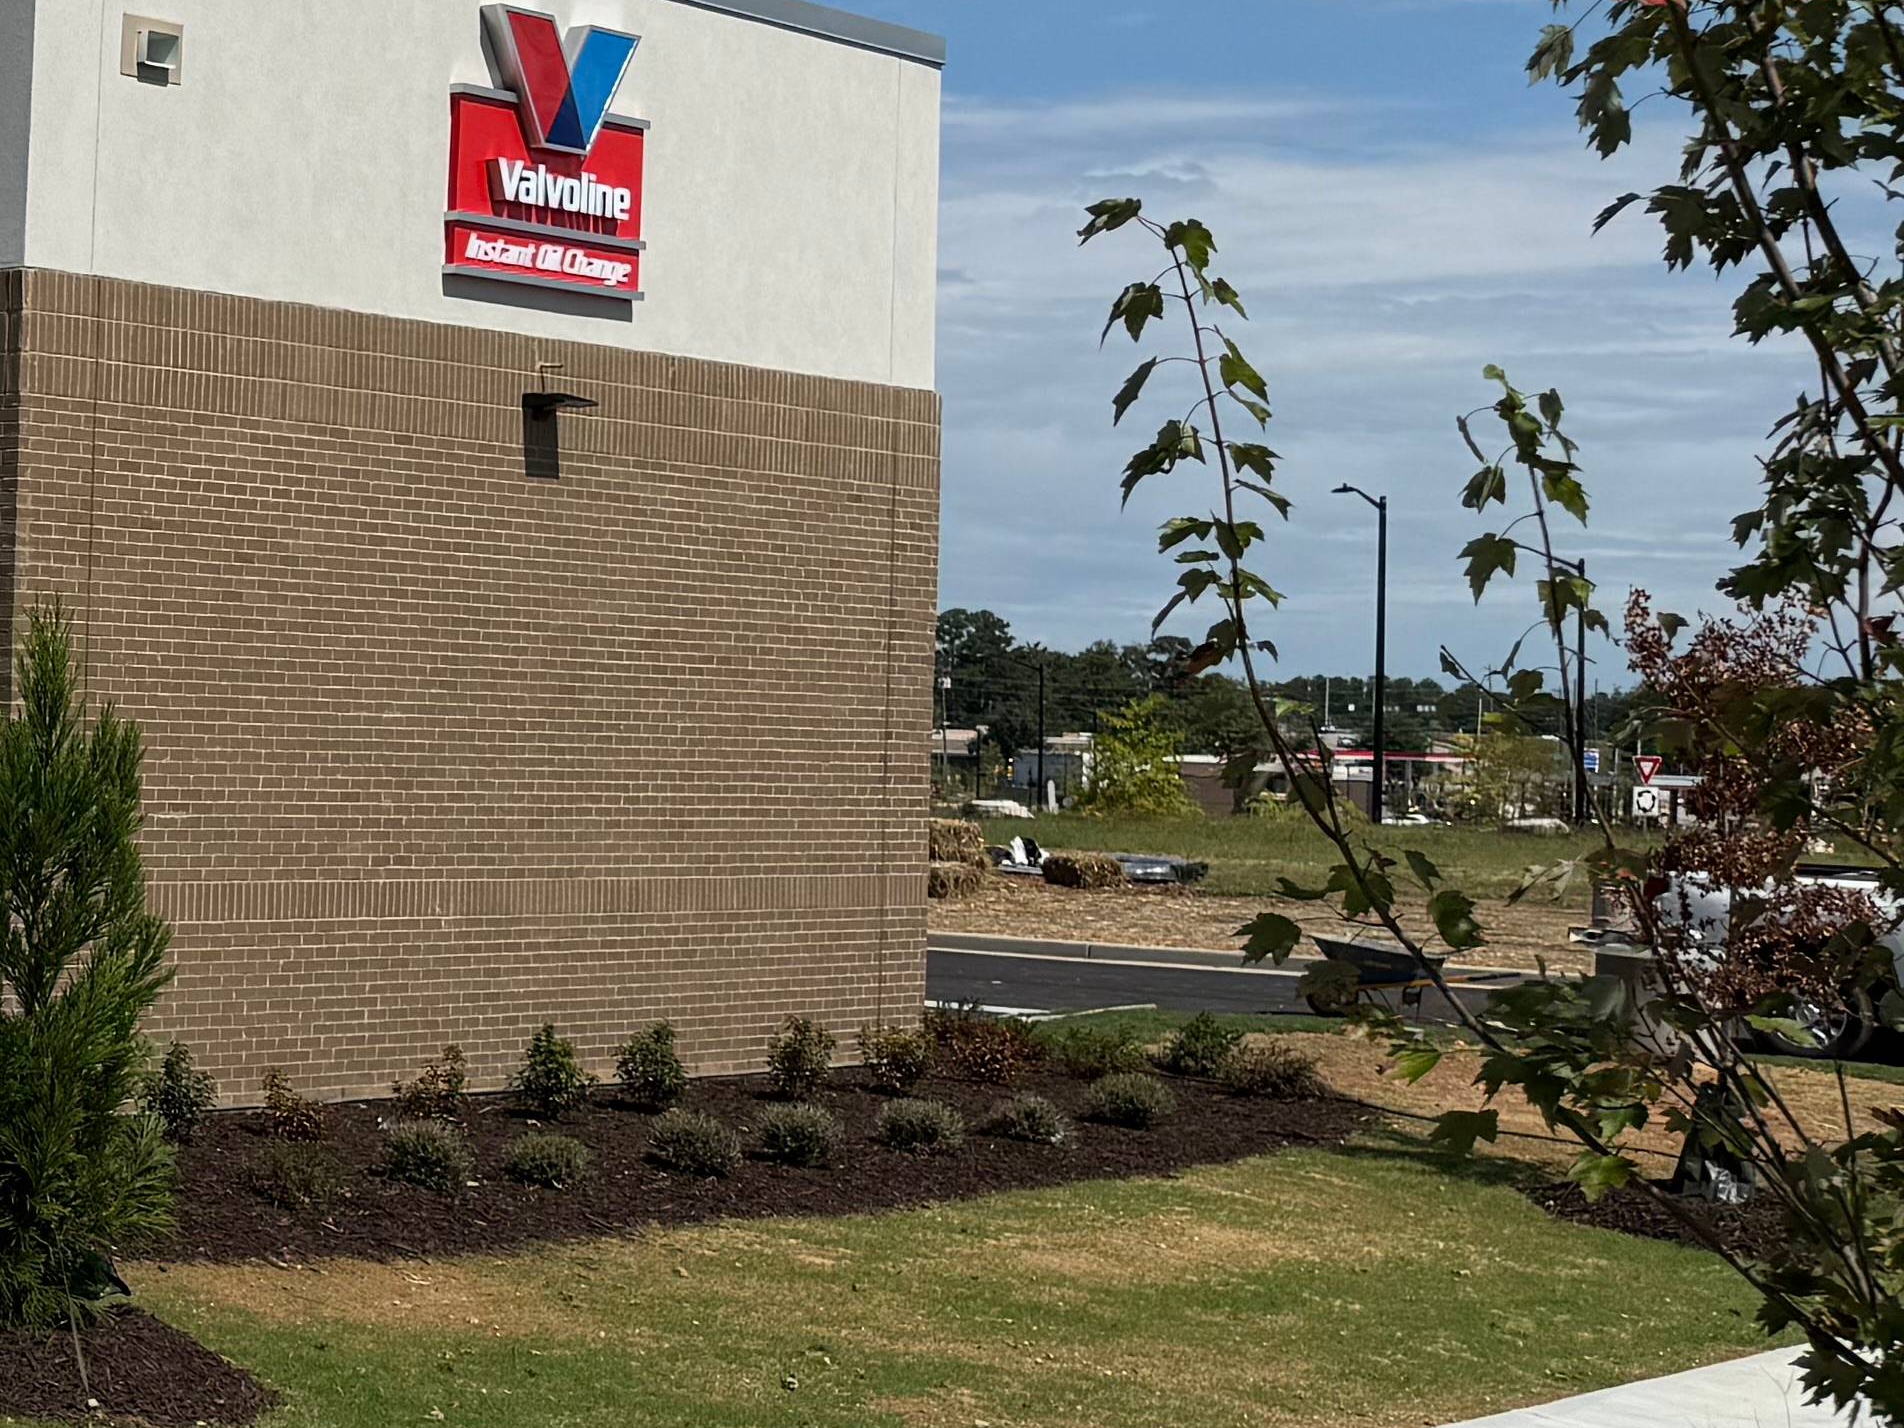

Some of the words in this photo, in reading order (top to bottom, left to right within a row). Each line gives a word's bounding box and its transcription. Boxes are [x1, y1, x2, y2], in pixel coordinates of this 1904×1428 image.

[497, 156, 632, 221] Valvoline
[464, 231, 537, 268] Instant
[535, 243, 565, 272] Oil
[562, 248, 632, 286] Change
